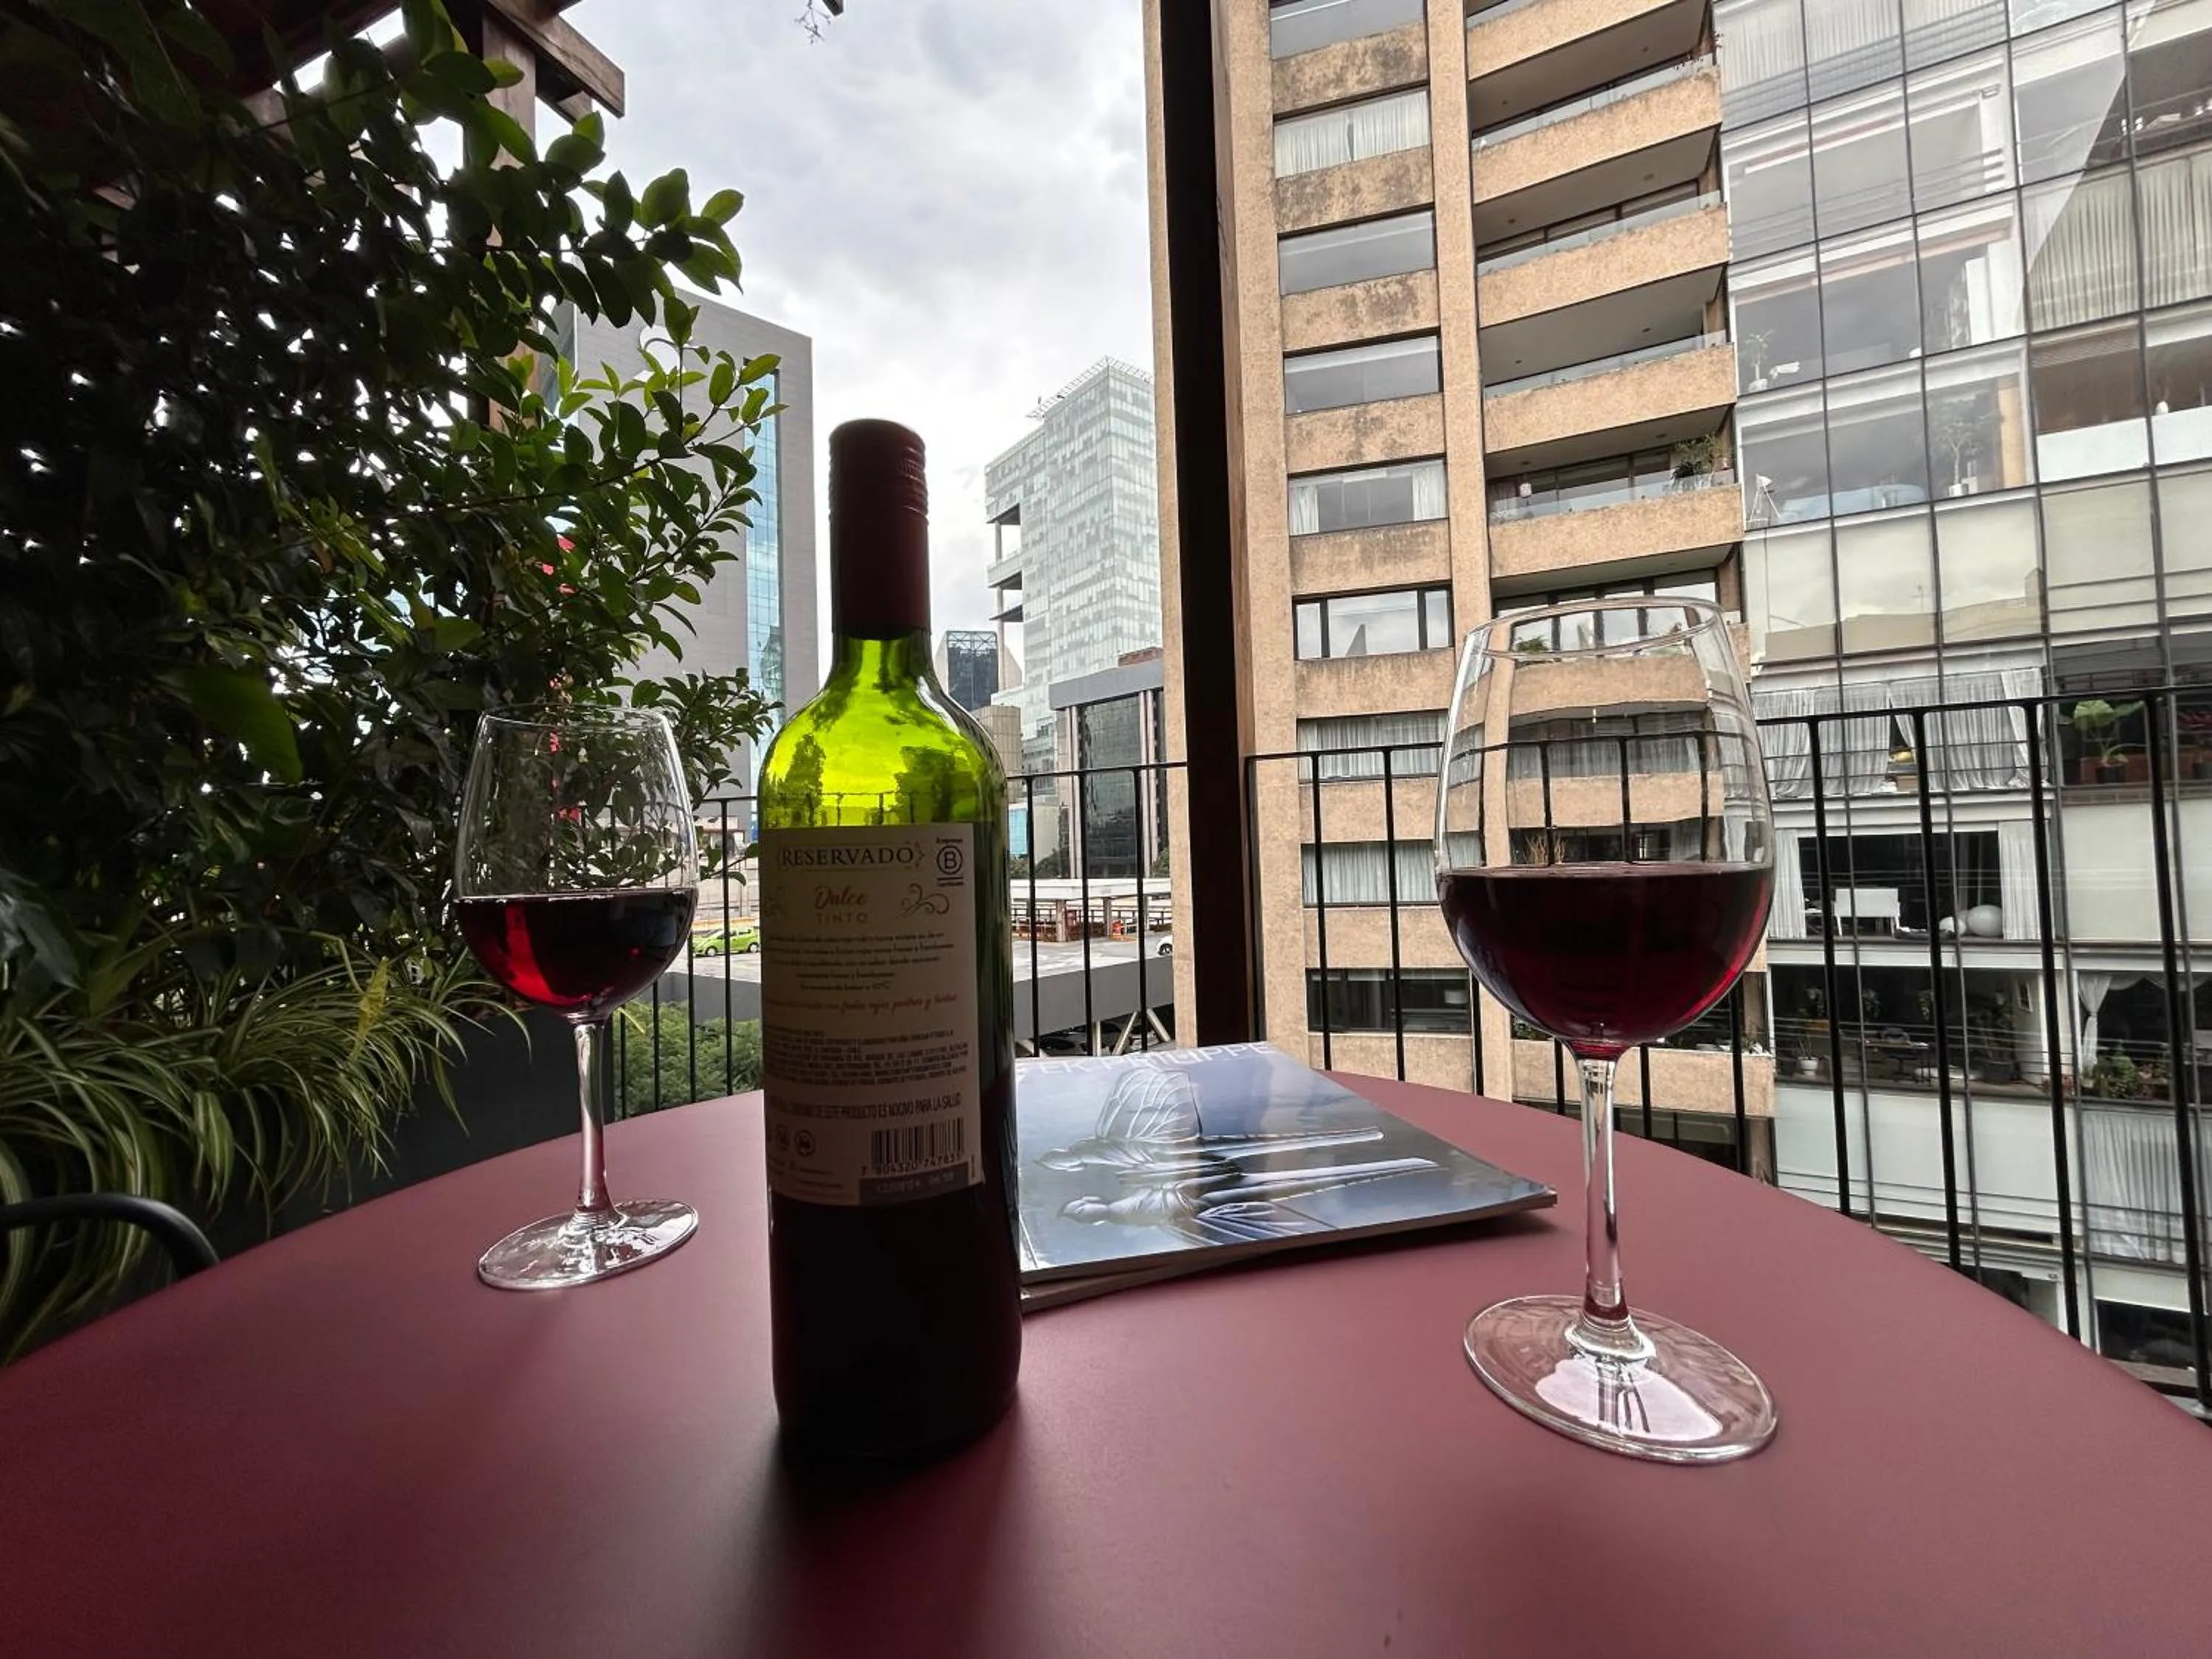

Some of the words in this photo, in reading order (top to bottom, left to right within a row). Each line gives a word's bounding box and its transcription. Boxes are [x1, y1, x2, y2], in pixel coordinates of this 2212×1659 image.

[782, 847, 914, 866] RESERVADO
[814, 886, 866, 910] Dulce
[815, 913, 868, 925] TINTO
[933, 1097, 942, 1110] LA
